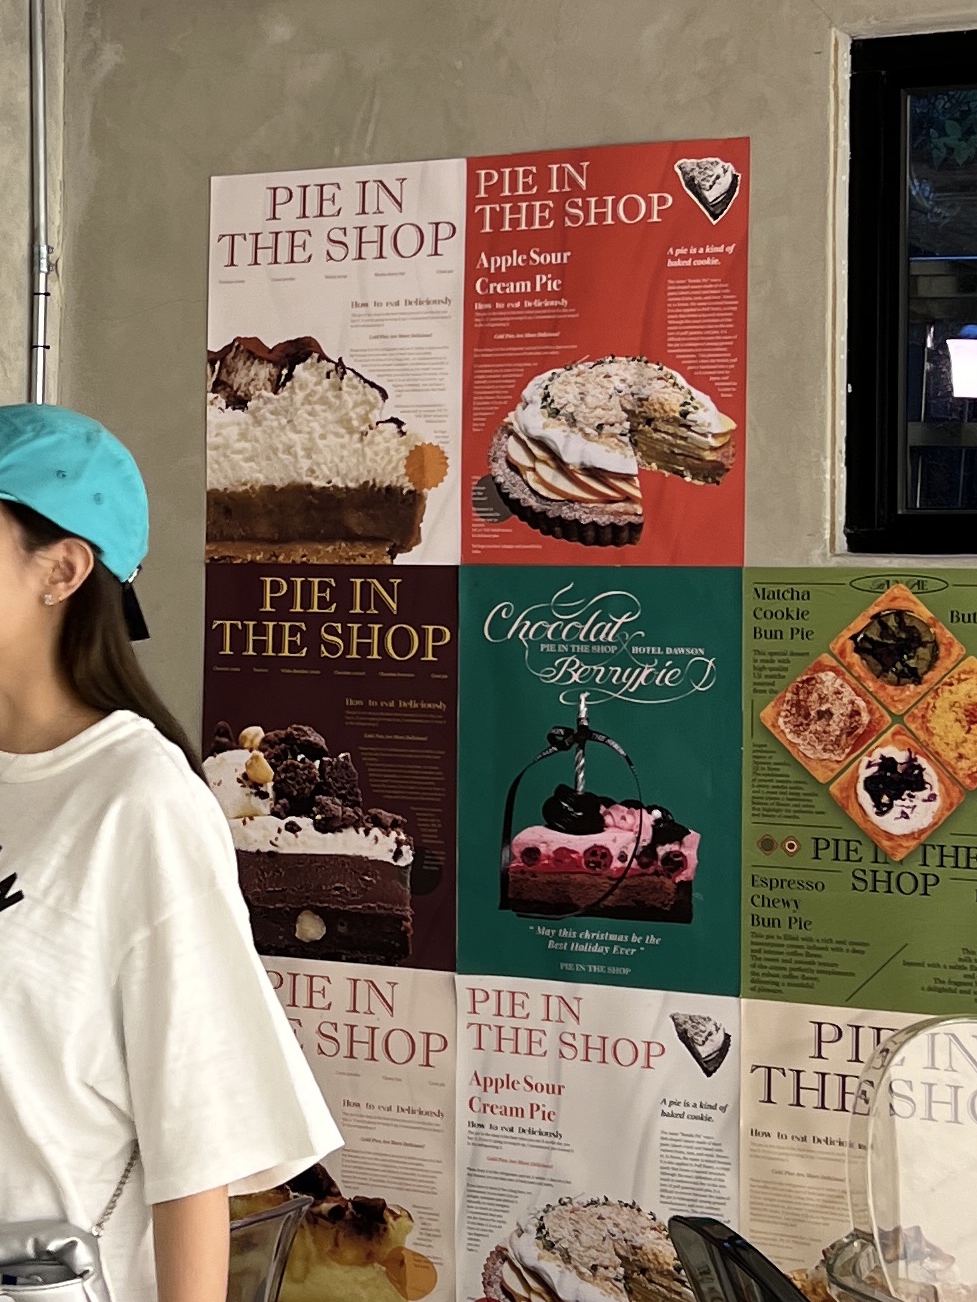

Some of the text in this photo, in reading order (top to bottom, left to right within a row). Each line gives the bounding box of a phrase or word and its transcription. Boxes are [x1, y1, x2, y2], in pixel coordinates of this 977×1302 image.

[475, 161, 590, 198] PIE IN
[265, 177, 408, 221] PIE IN
[474, 192, 673, 233] THE SHOP
[217, 221, 457, 267] THE SHOP
[705, 244, 724, 254] kind
[725, 243, 736, 255] of
[475, 247, 572, 273] Apple Sour
[667, 258, 691, 268] baked
[475, 273, 562, 295] Cream Pie
[259, 576, 402, 615] PIE IN
[753, 587, 811, 601] Matcha
[483, 588, 641, 643] Chocolat
[753, 606, 810, 621] Cookie
[212, 620, 451, 661] THE SHOP
[753, 626, 815, 641] Bun Pie
[540, 643, 618, 654] PIE IN THE SHOP
[631, 646, 705, 656] HOTEL DAWSON
[811, 837, 863, 863] PIE
[751, 874, 825, 893] Espresso
[851, 868, 941, 897] SHOP
[750, 894, 800, 914] Chewy
[750, 913, 813, 932] Bun Pie
[536, 926, 661, 945] May this christmas be the
[548, 939, 636, 956] Best Holiday Ever
[559, 962, 574, 971] PIE
[588, 964, 606, 973] THE
[607, 966, 632, 975] SHOP
[346, 977, 399, 1018] IN
[466, 987, 584, 1026] PIE IN
[316, 1021, 449, 1069] SHOP
[466, 1022, 666, 1070] THE SHOP
[468, 1070, 566, 1096] Apple Sour
[750, 1064, 874, 1116] THE
[468, 1096, 556, 1123] Cream Pie
[660, 1109, 685, 1119] baked
[668, 1099, 681, 1108] pie
[683, 1099, 690, 1108] is
[699, 1101, 718, 1110] kind
[719, 1103, 729, 1113] of
[750, 1128, 772, 1138] How
